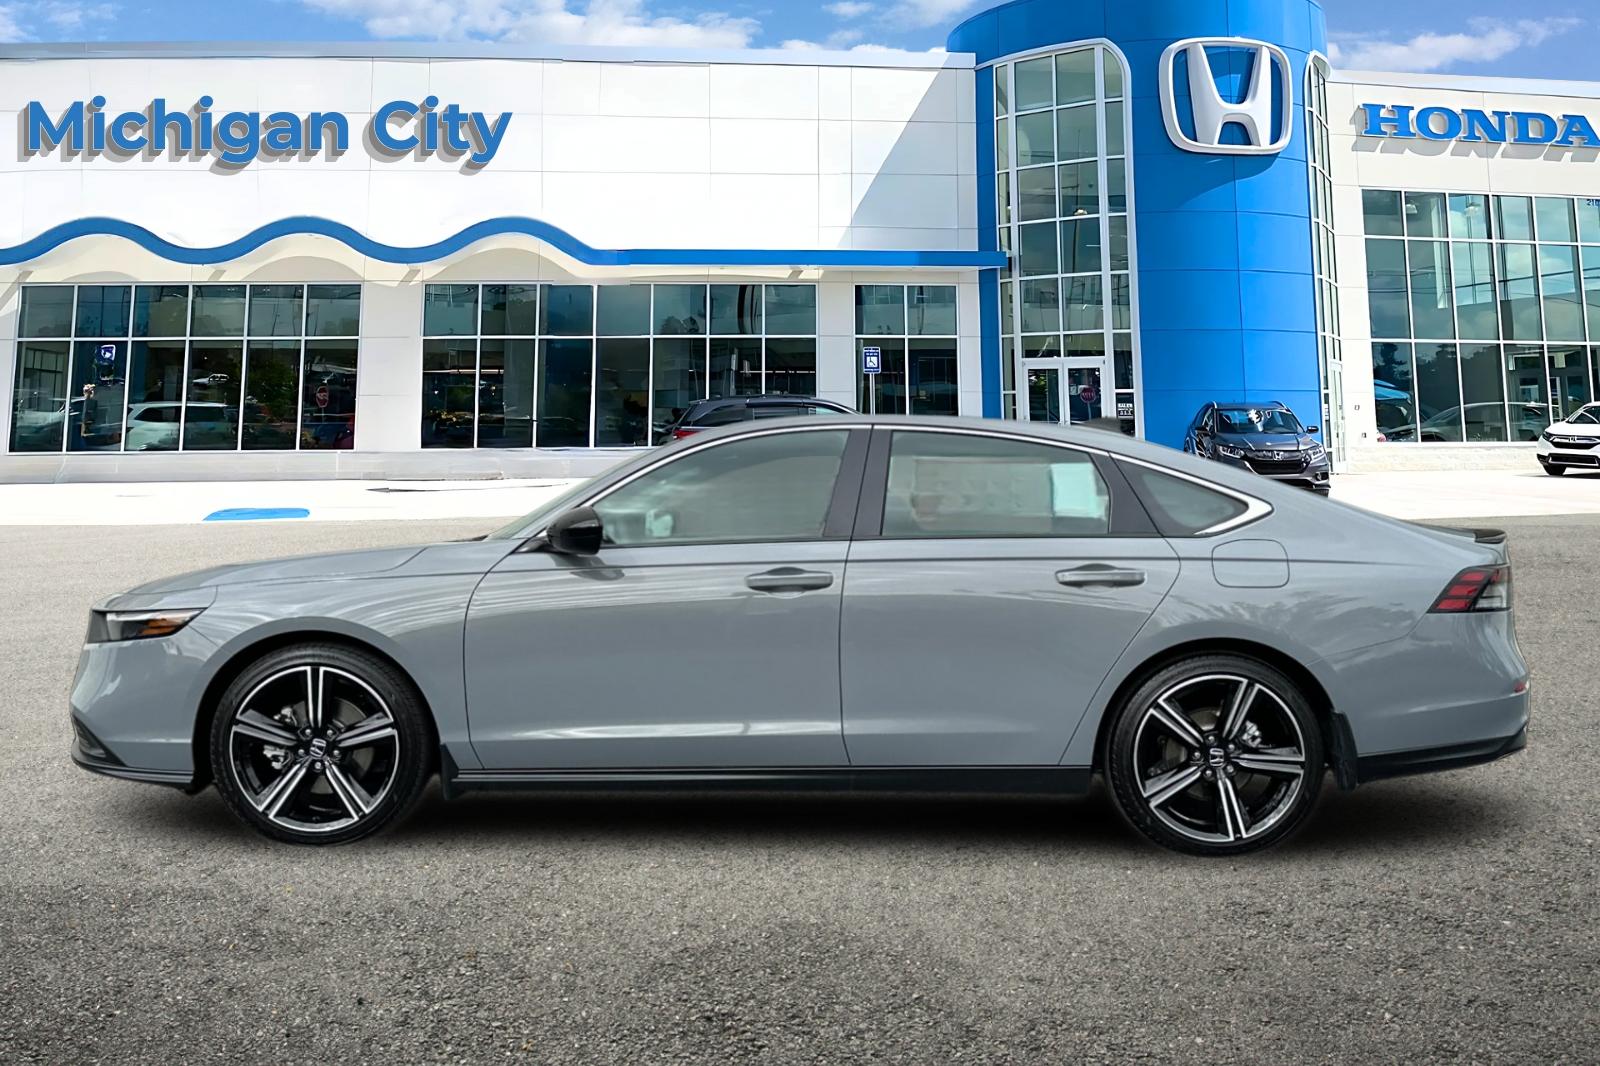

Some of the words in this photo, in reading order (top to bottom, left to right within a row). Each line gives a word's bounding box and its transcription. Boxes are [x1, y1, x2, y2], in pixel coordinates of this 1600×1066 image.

[28, 95, 349, 164] Michigan
[373, 95, 513, 164] City
[1361, 102, 1600, 148] HONDA
